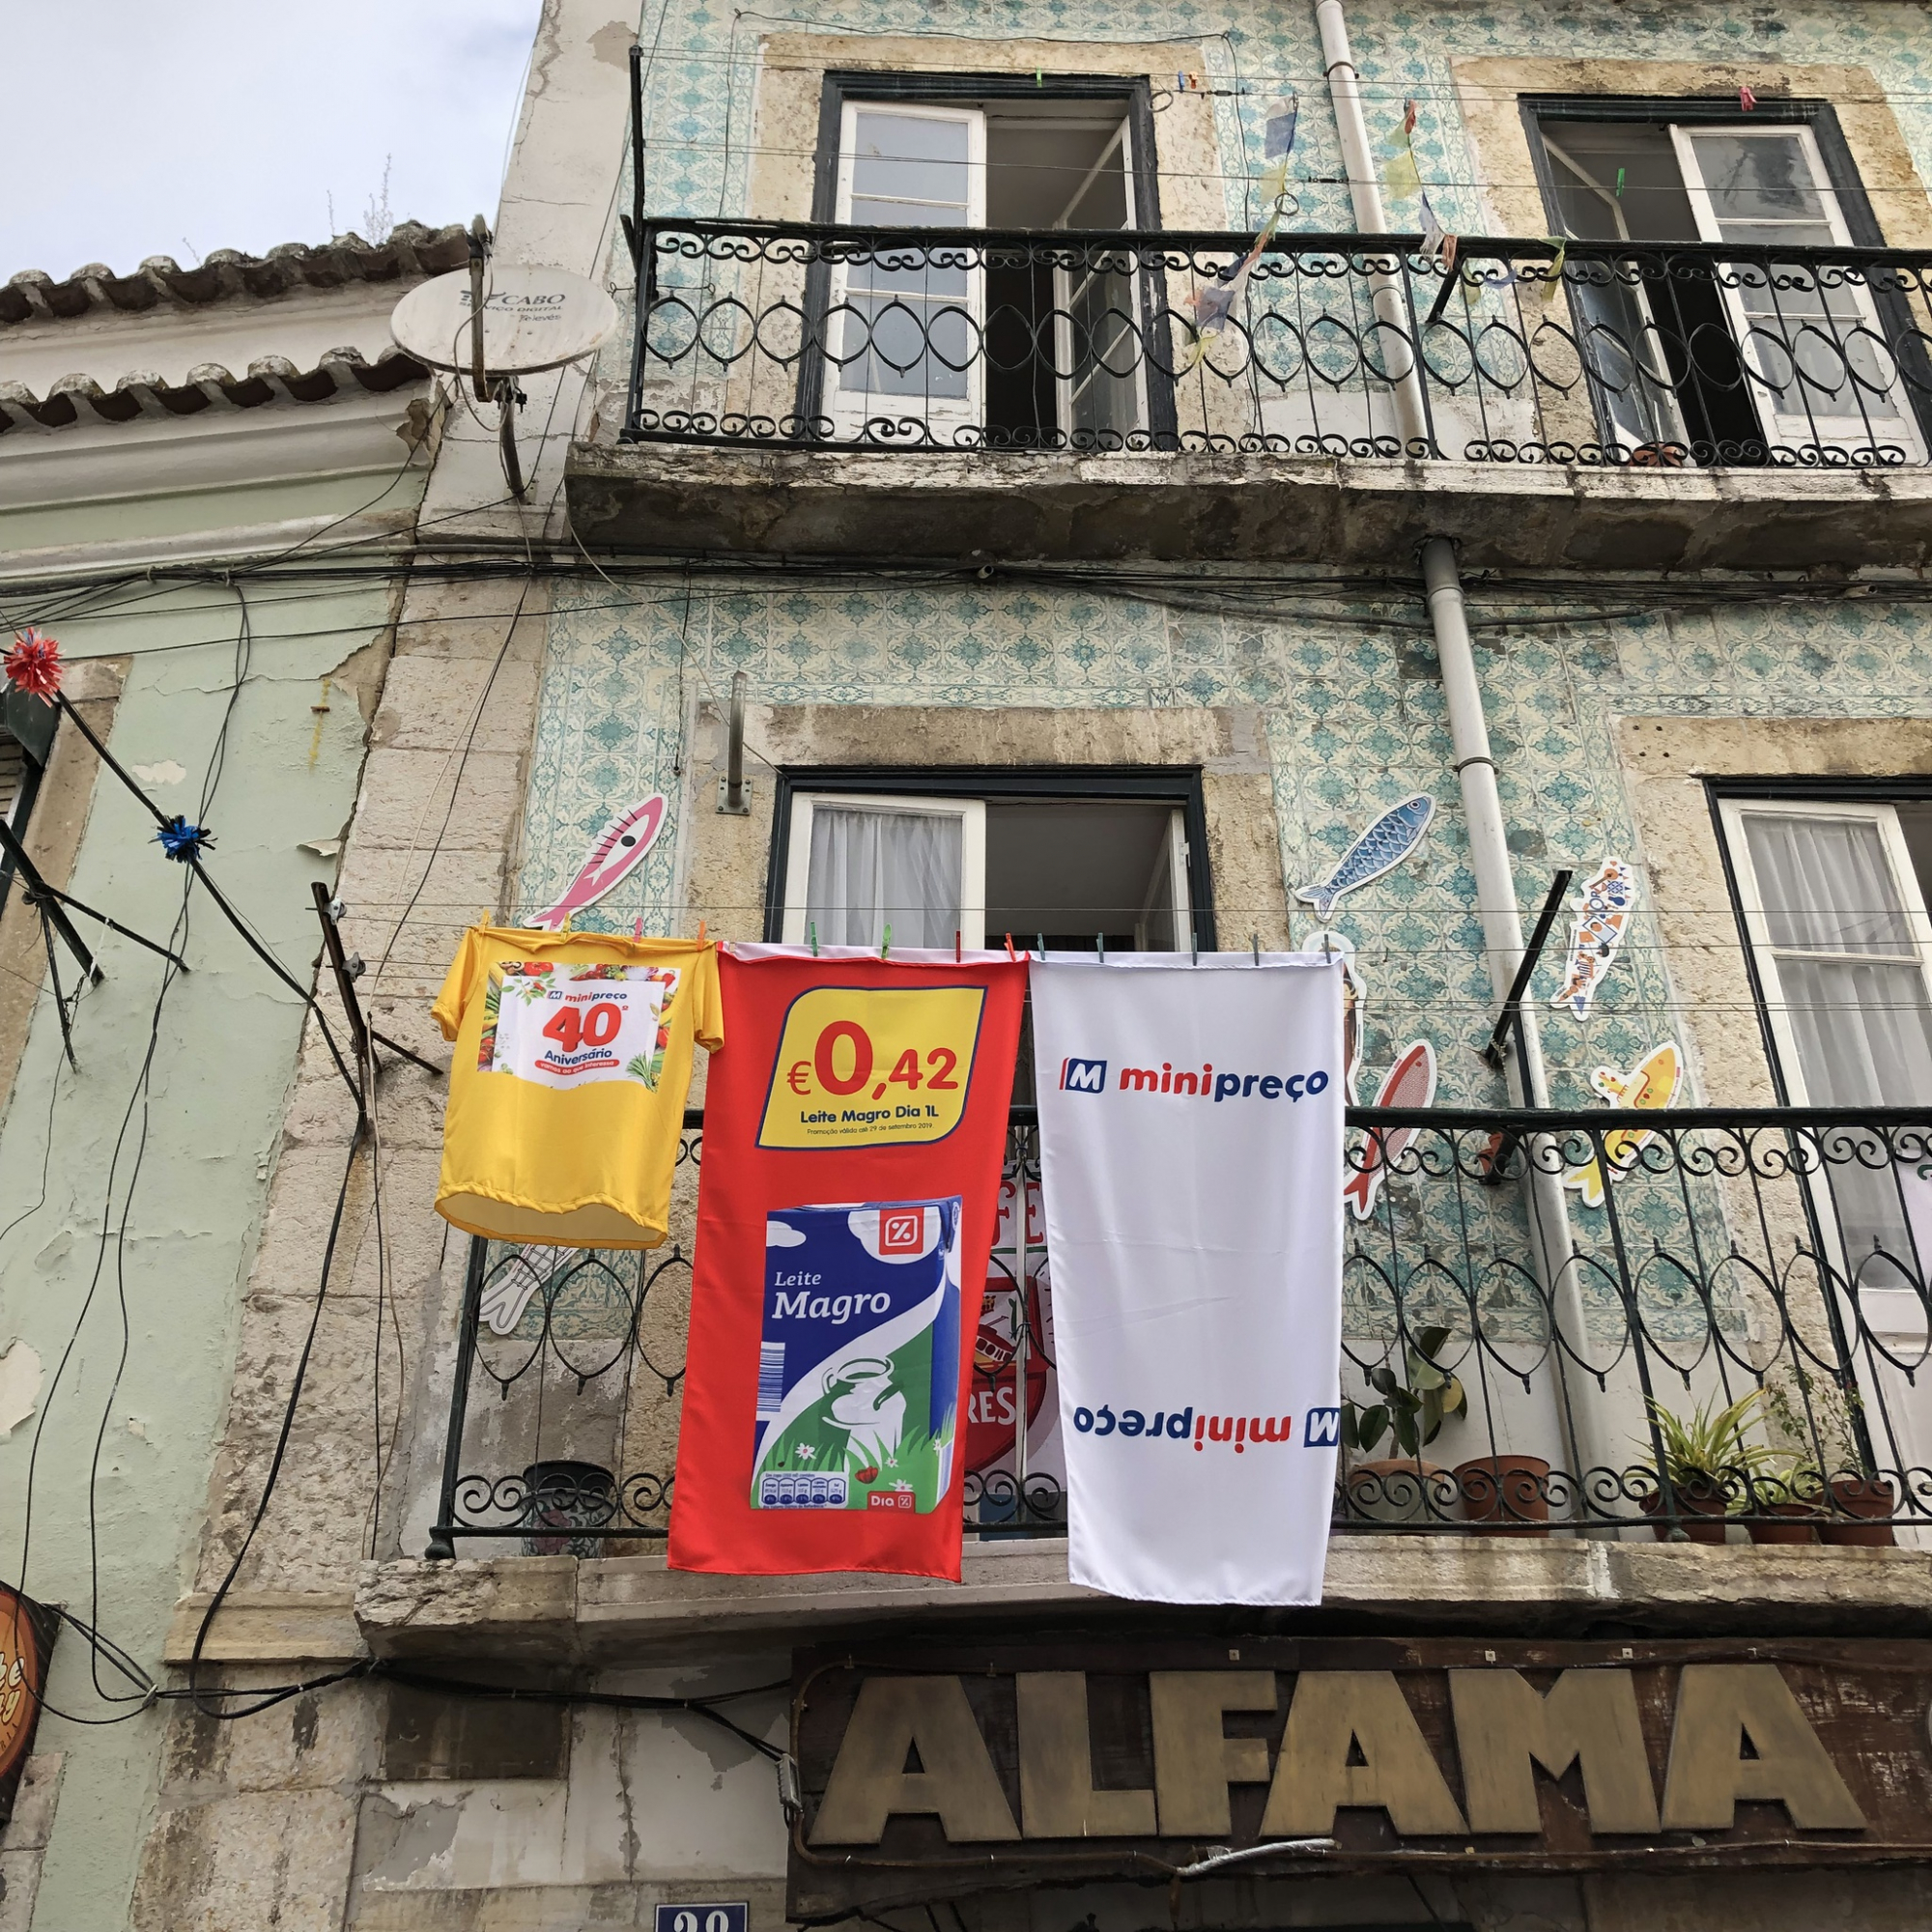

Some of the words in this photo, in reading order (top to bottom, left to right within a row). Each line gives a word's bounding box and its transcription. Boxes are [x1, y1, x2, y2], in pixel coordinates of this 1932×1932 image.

[501, 294, 566, 305] CABO
[565, 992, 628, 1003] minipreço
[544, 1048, 612, 1065] Aniversário
[1120, 1063, 1329, 1103] minipreço
[801, 1110, 837, 1123] Leite
[841, 1110, 891, 1123] Magro
[895, 1105, 921, 1118] Dia
[924, 1105, 939, 1117] 1L
[775, 1270, 822, 1287] Leite
[772, 1291, 891, 1324] Magro
[1074, 1405, 1292, 1454] minipreço
[809, 1663, 1867, 1844] ALFAMA
